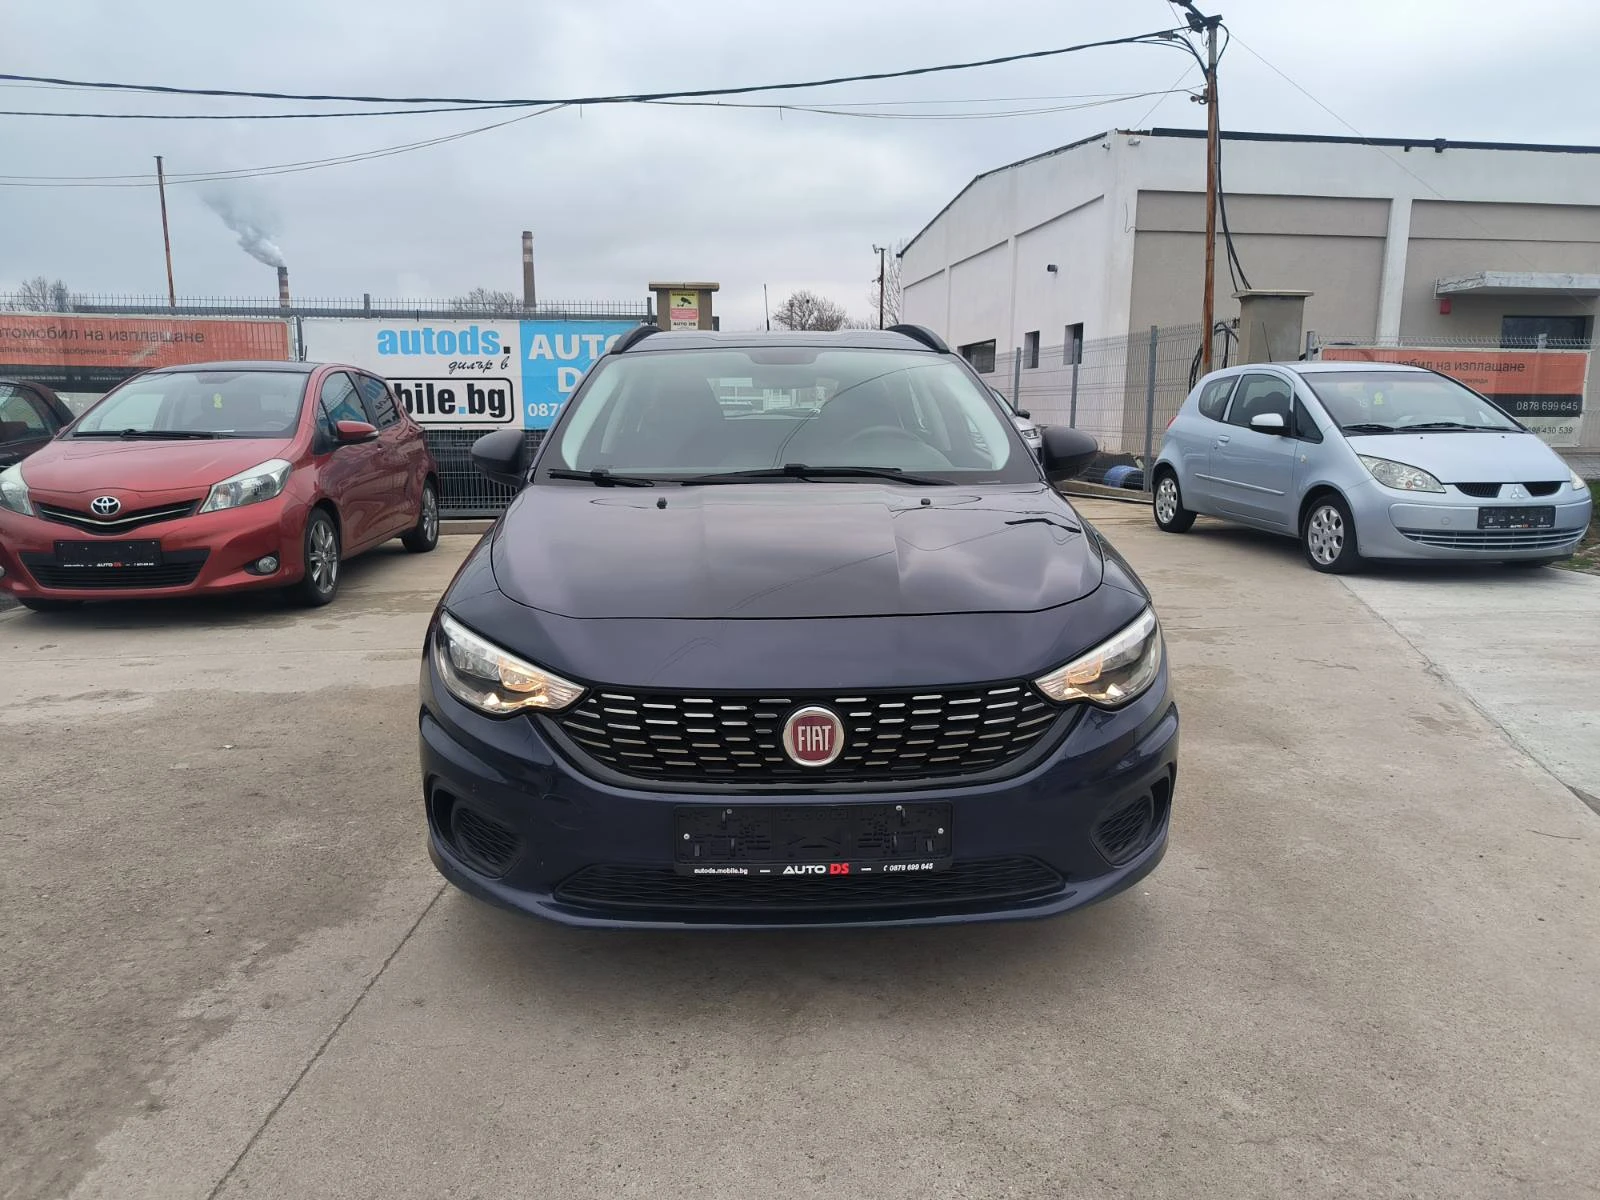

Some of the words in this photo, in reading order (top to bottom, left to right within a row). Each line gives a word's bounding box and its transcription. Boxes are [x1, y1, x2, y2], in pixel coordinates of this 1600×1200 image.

[0, 325, 79, 340] томобил
[84, 329, 104, 341] на
[109, 330, 205, 344] изплащане
[377, 325, 511, 355] autods.
[448, 360, 493, 375] дилър
[1436, 361, 1451, 371] на
[1454, 360, 1526, 373] изплащане
[393, 383, 506, 418] bile.bg
[1516, 401, 1540, 411] 0878
[1541, 401, 1559, 411] 699
[1560, 401, 1578, 411] 645
[527, 403, 564, 417] 087
[1558, 426, 1574, 434] 539
[797, 725, 832, 752] FIAT
[783, 865, 826, 874] AUTO
[830, 863, 849, 875] DS
[889, 864, 906, 872] 0878
[907, 863, 920, 871] 699
[921, 862, 934, 870] 645
